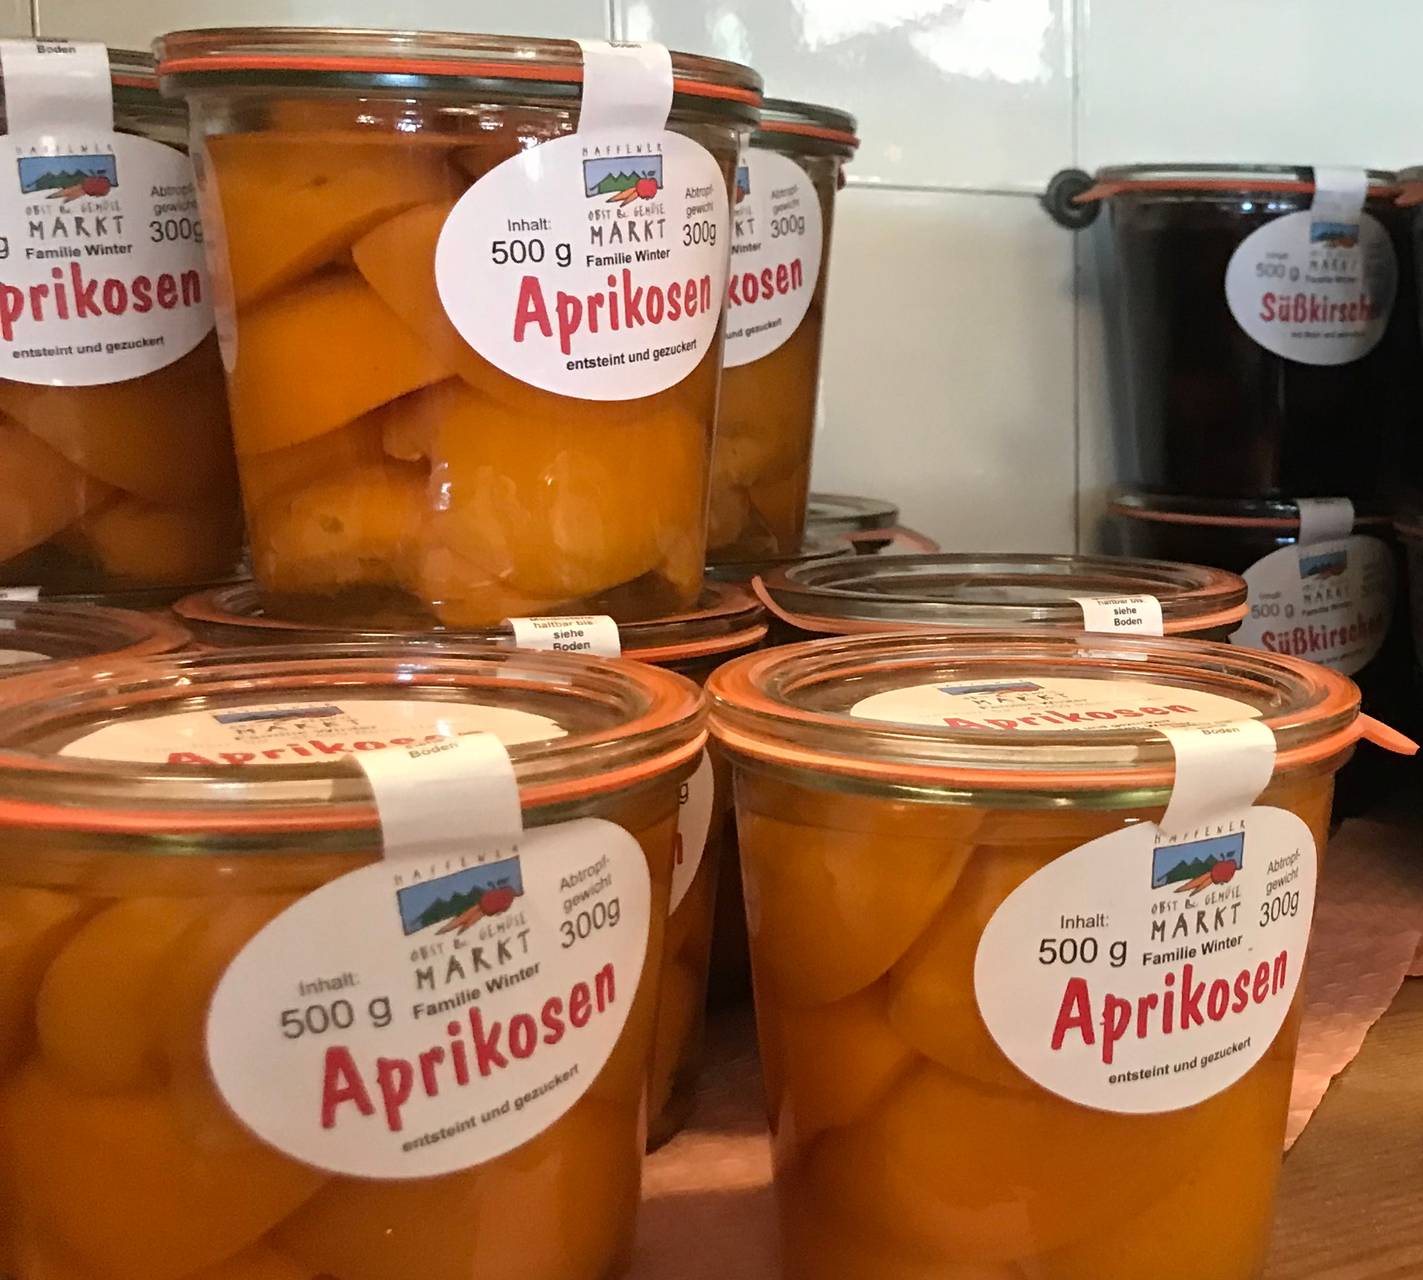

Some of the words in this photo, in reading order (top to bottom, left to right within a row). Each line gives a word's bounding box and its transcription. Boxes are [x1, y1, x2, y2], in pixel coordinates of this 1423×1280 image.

[37, 45, 76, 54] Boden
[507, 218, 552, 232] Inhalt:
[587, 209, 612, 221] OBST
[634, 205, 665, 218] GEMÜSE
[771, 214, 805, 239] 300g
[29, 216, 124, 240] MARKT
[25, 246, 81, 260] Familie
[84, 241, 133, 256] Winter
[491, 239, 546, 265] 500
[555, 243, 572, 267] g
[590, 219, 667, 247] MARKT
[682, 220, 717, 247] 300g
[586, 252, 632, 268] Familie
[635, 247, 671, 263] Winter
[728, 258, 803, 309] kosen
[513, 268, 711, 355] Aprikosen
[1260, 292, 1375, 323] Süßkirsch
[12, 344, 73, 360] entsteint
[76, 341, 103, 355] und
[105, 335, 165, 354] gezuckert
[566, 353, 626, 371] entsteint
[628, 349, 651, 364] und
[653, 338, 697, 360] gezuckert
[1113, 607, 1136, 615] siehe
[1114, 618, 1142, 626] Boden
[1251, 604, 1280, 619] 500
[553, 630, 584, 639] siehe
[553, 641, 591, 651] Boden
[943, 702, 1198, 731] Aprikosen
[1266, 867, 1300, 896] gewicht
[1151, 900, 1179, 914] OBST
[1205, 885, 1241, 906] GEMÜSE
[1038, 938, 1098, 965] 500
[1109, 940, 1127, 968] g
[1151, 902, 1241, 942] MARKT
[1259, 891, 1300, 928] 300g
[1060, 913, 1109, 930] Inhalt:
[1142, 947, 1196, 966] Familie
[1201, 934, 1243, 955] Winter
[280, 996, 356, 1039] 500
[368, 996, 393, 1028] g
[415, 929, 531, 990] MARKT
[560, 898, 621, 949] 300g
[412, 988, 481, 1019] Familie
[485, 962, 540, 994] Winter
[1051, 950, 1287, 1065] Aprikosen
[320, 962, 617, 1132] Aprikosen
[1108, 1062, 1170, 1085] entsteint
[1173, 1056, 1198, 1074] und
[1200, 1036, 1251, 1069] gezuckert
[401, 1115, 477, 1152] entsteint
[481, 1102, 512, 1125] und
[513, 1062, 580, 1112] gezuckert
